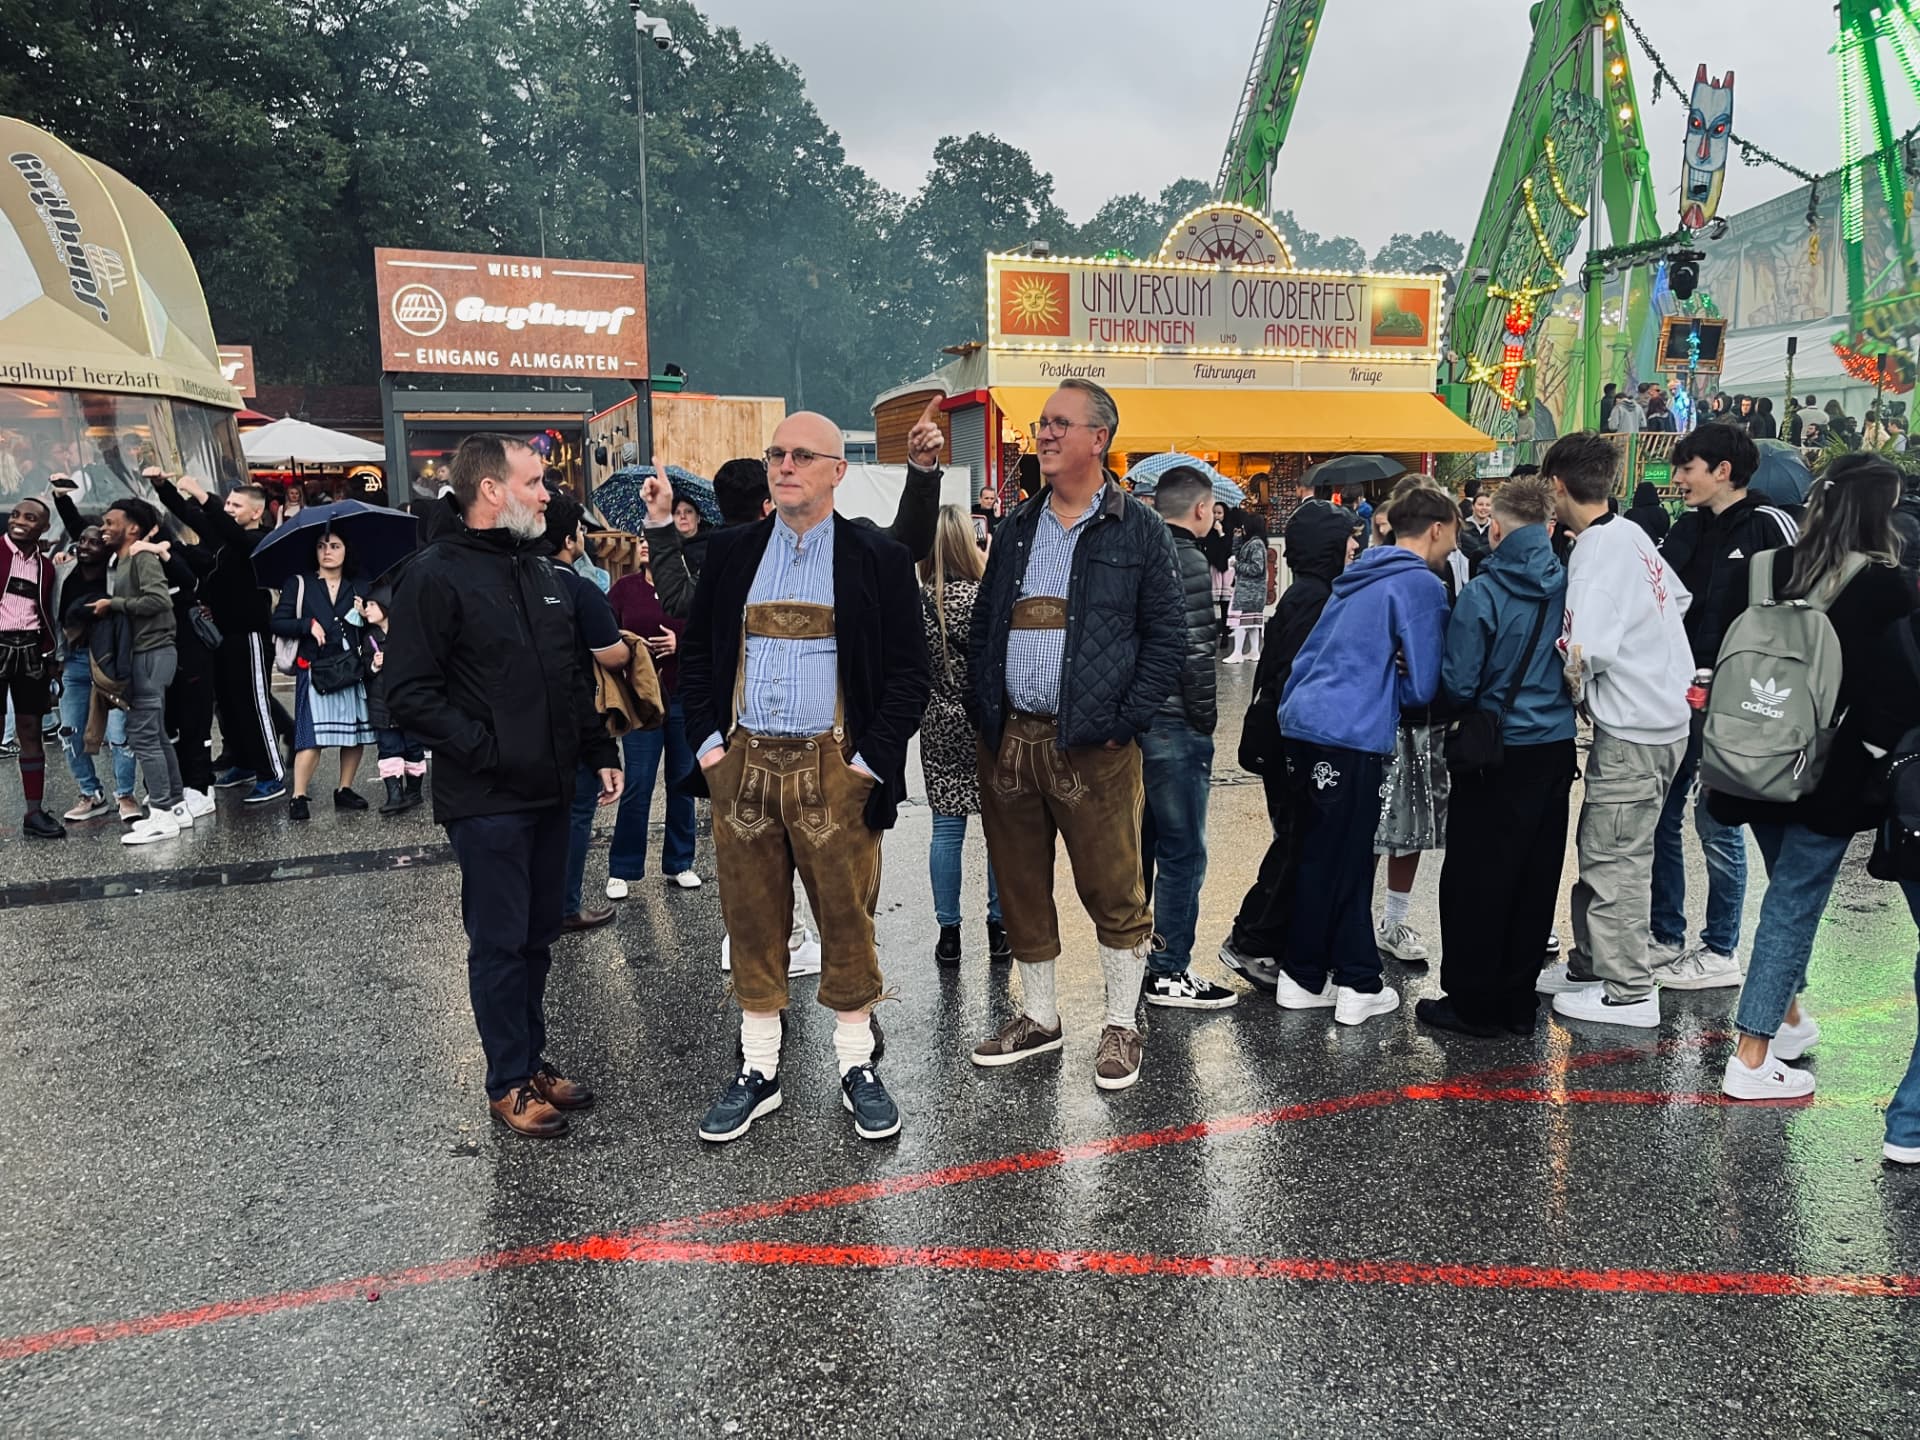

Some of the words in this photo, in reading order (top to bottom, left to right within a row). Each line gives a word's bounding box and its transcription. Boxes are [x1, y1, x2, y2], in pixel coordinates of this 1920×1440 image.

[9, 152, 109, 323] Guglhupf
[487, 263, 542, 279] WIESN
[1080, 270, 1212, 317] UNIVERSUM
[1231, 278, 1367, 322] OKTOBERFEST
[454, 296, 636, 335] Guglhupf
[1088, 317, 1195, 345] FÜHRUNGEN
[1219, 333, 1237, 345] UND
[1264, 323, 1357, 349] ANDENKEN
[416, 348, 499, 366] EINGANG
[510, 353, 619, 371] ALMGARTEN
[1039, 361, 1106, 379] Postkarten
[83, 367, 160, 388] herzhaft
[1193, 363, 1257, 383] Führungen
[1348, 365, 1383, 384] Krüge
[1740, 700, 1785, 720] adidas
